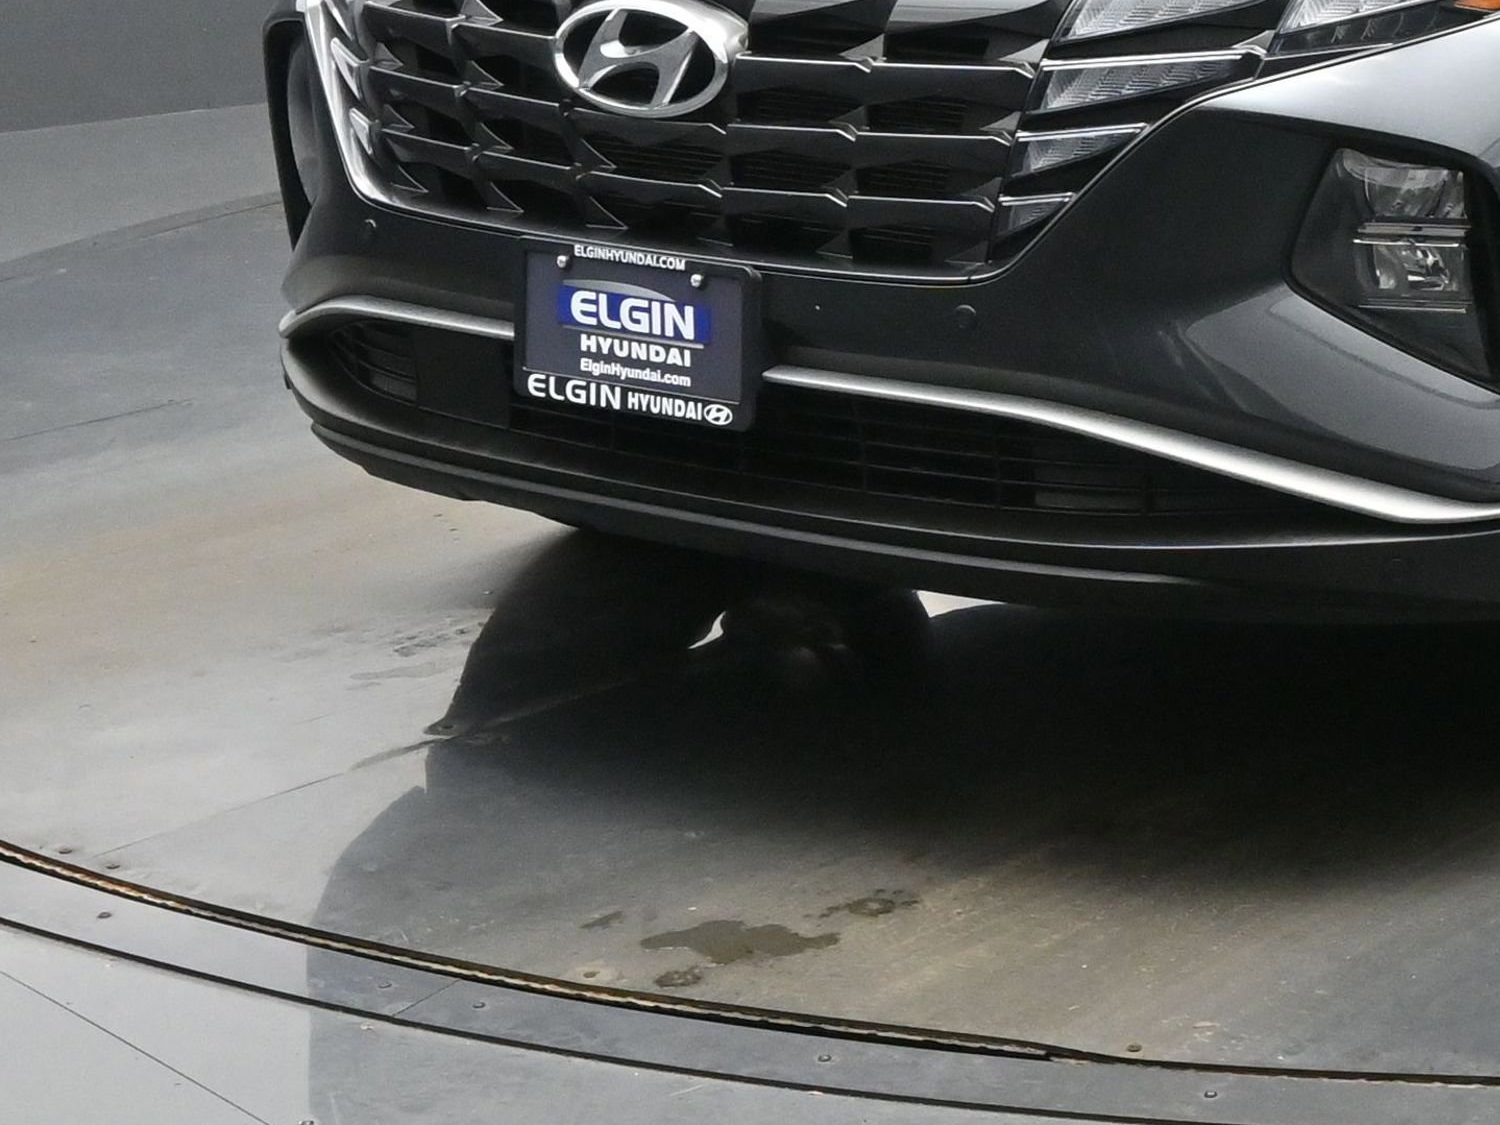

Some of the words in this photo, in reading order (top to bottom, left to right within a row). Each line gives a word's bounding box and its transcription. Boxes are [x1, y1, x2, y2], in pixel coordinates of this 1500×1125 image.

[574, 244, 686, 271] ELGINHYUNDAI.COM
[570, 290, 695, 340] ELGIN
[580, 334, 691, 367] HYUNDAI
[580, 358, 691, 387] ElginHyundai.com
[527, 373, 621, 410] ELGIN
[628, 391, 702, 421] HYUNDAI
